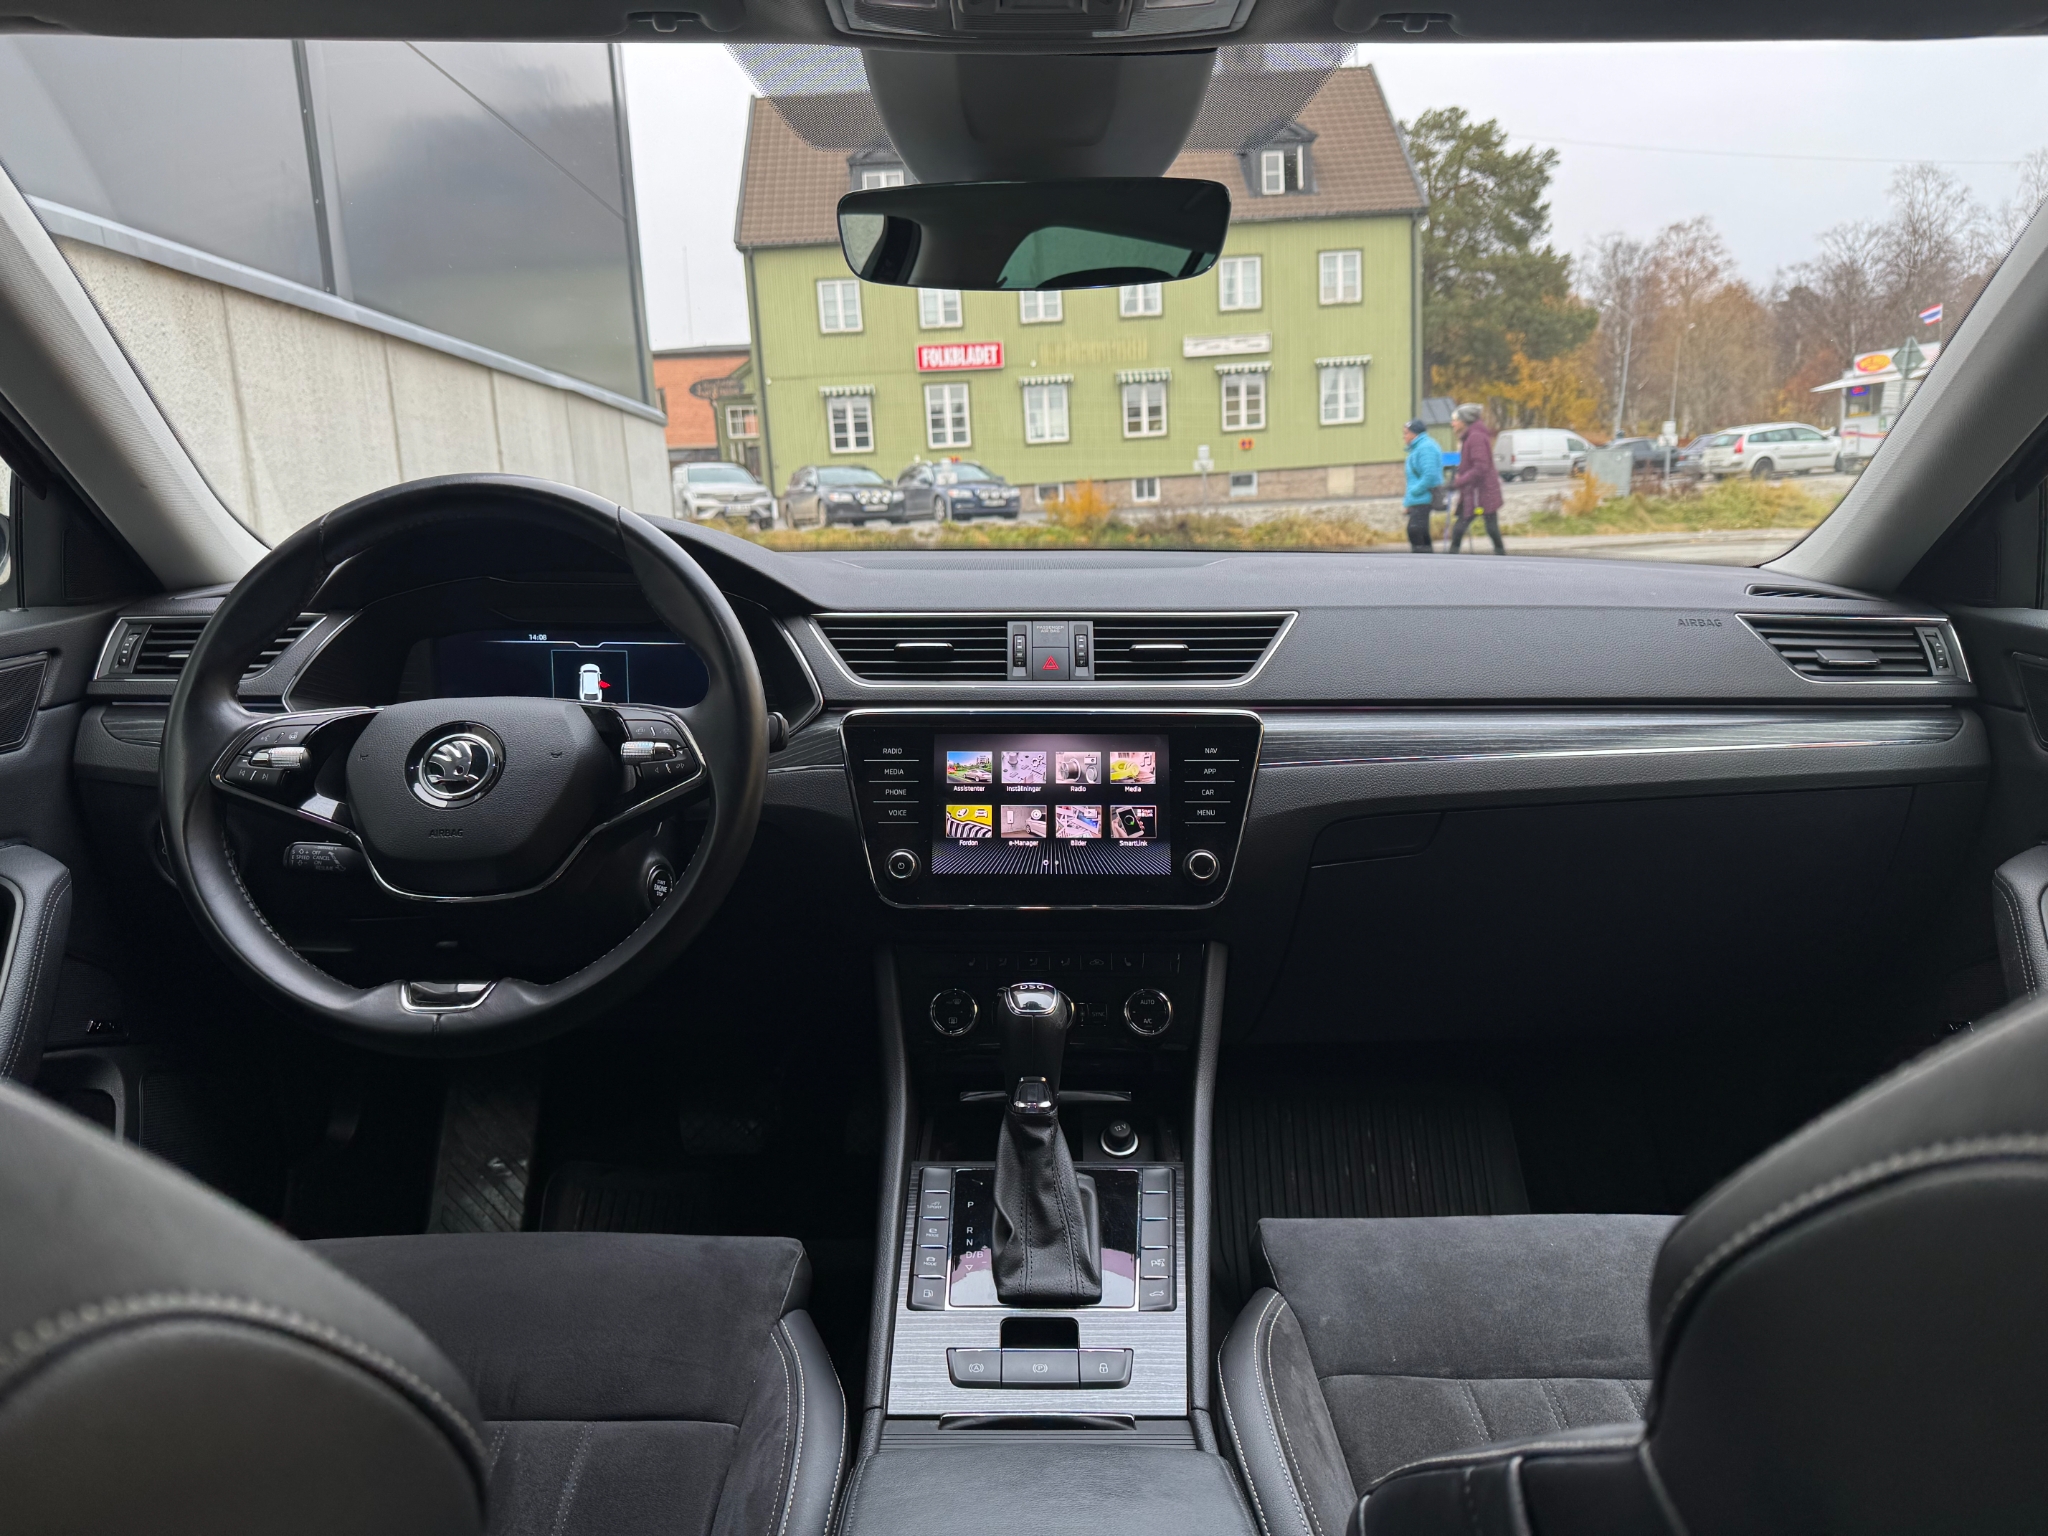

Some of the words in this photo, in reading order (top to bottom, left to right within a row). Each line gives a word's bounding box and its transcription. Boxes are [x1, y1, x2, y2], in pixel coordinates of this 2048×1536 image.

[921, 344, 999, 369] FOLKBLADET
[1678, 618, 1722, 627] AIRBAG
[882, 747, 903, 755] RADIO
[885, 788, 907, 796] PHONE
[1201, 788, 1215, 796] CAR
[429, 829, 464, 838] AIRBAG
[1008, 839, 1039, 847] e-Manager
[966, 1226, 974, 1234] R
[966, 1238, 974, 1246] N
[965, 1251, 984, 1259] D/B
